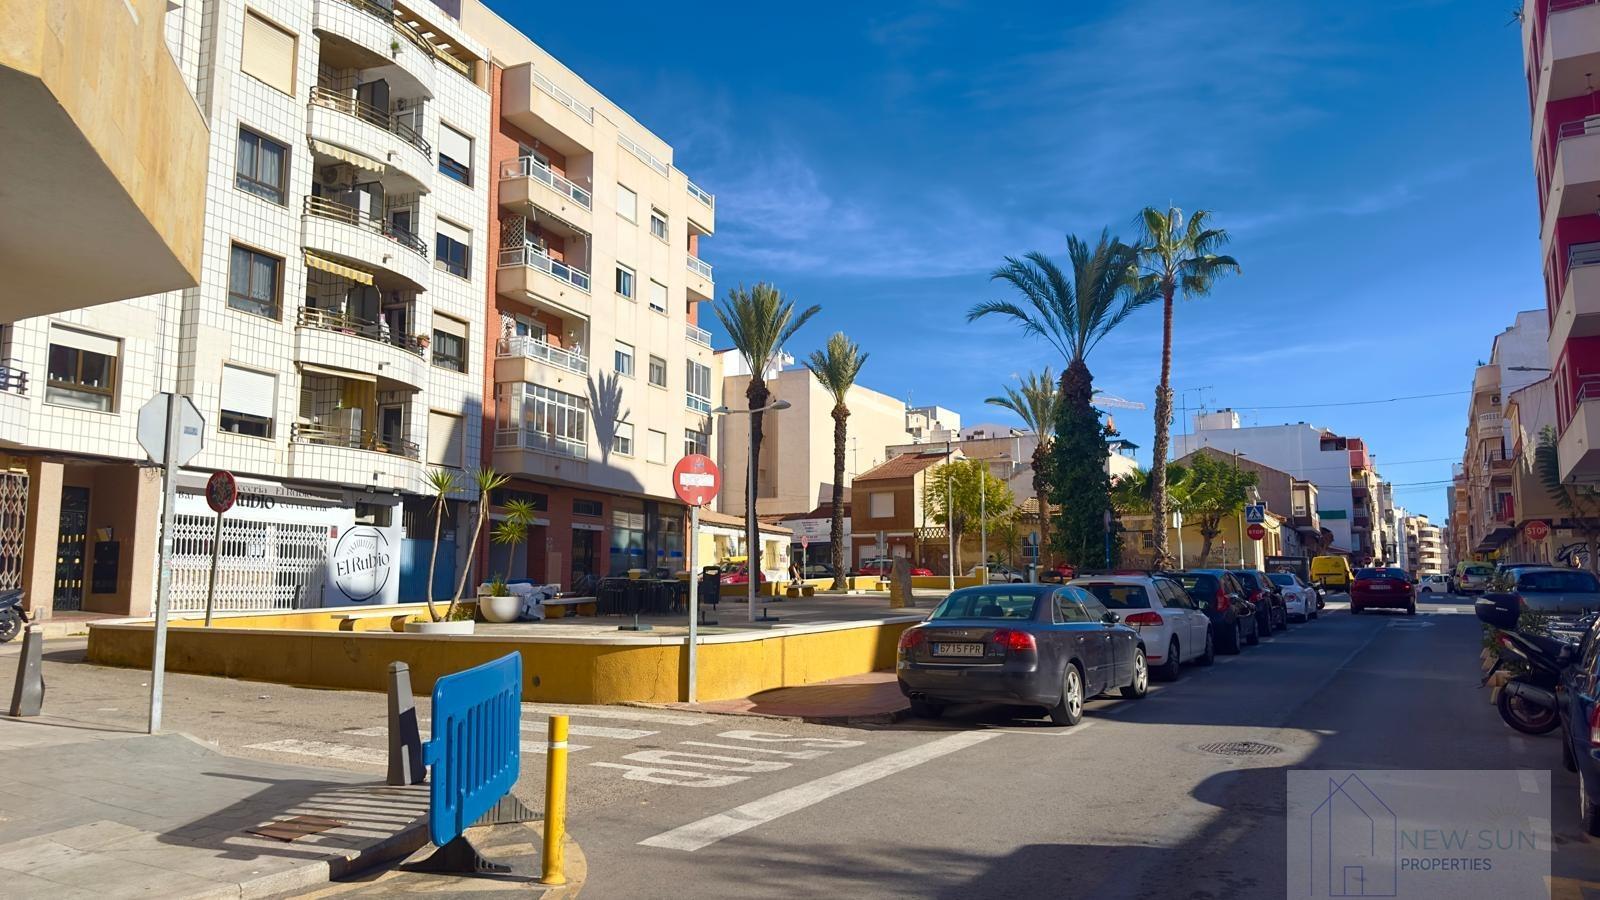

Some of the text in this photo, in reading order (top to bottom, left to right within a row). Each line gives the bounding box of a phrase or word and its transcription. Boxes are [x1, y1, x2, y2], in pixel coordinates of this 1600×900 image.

[1527, 526, 1548, 535] STOP
[336, 552, 390, 576] El Rubio
[940, 644, 981, 653] 6715 FPR
[588, 730, 866, 787] STOP
